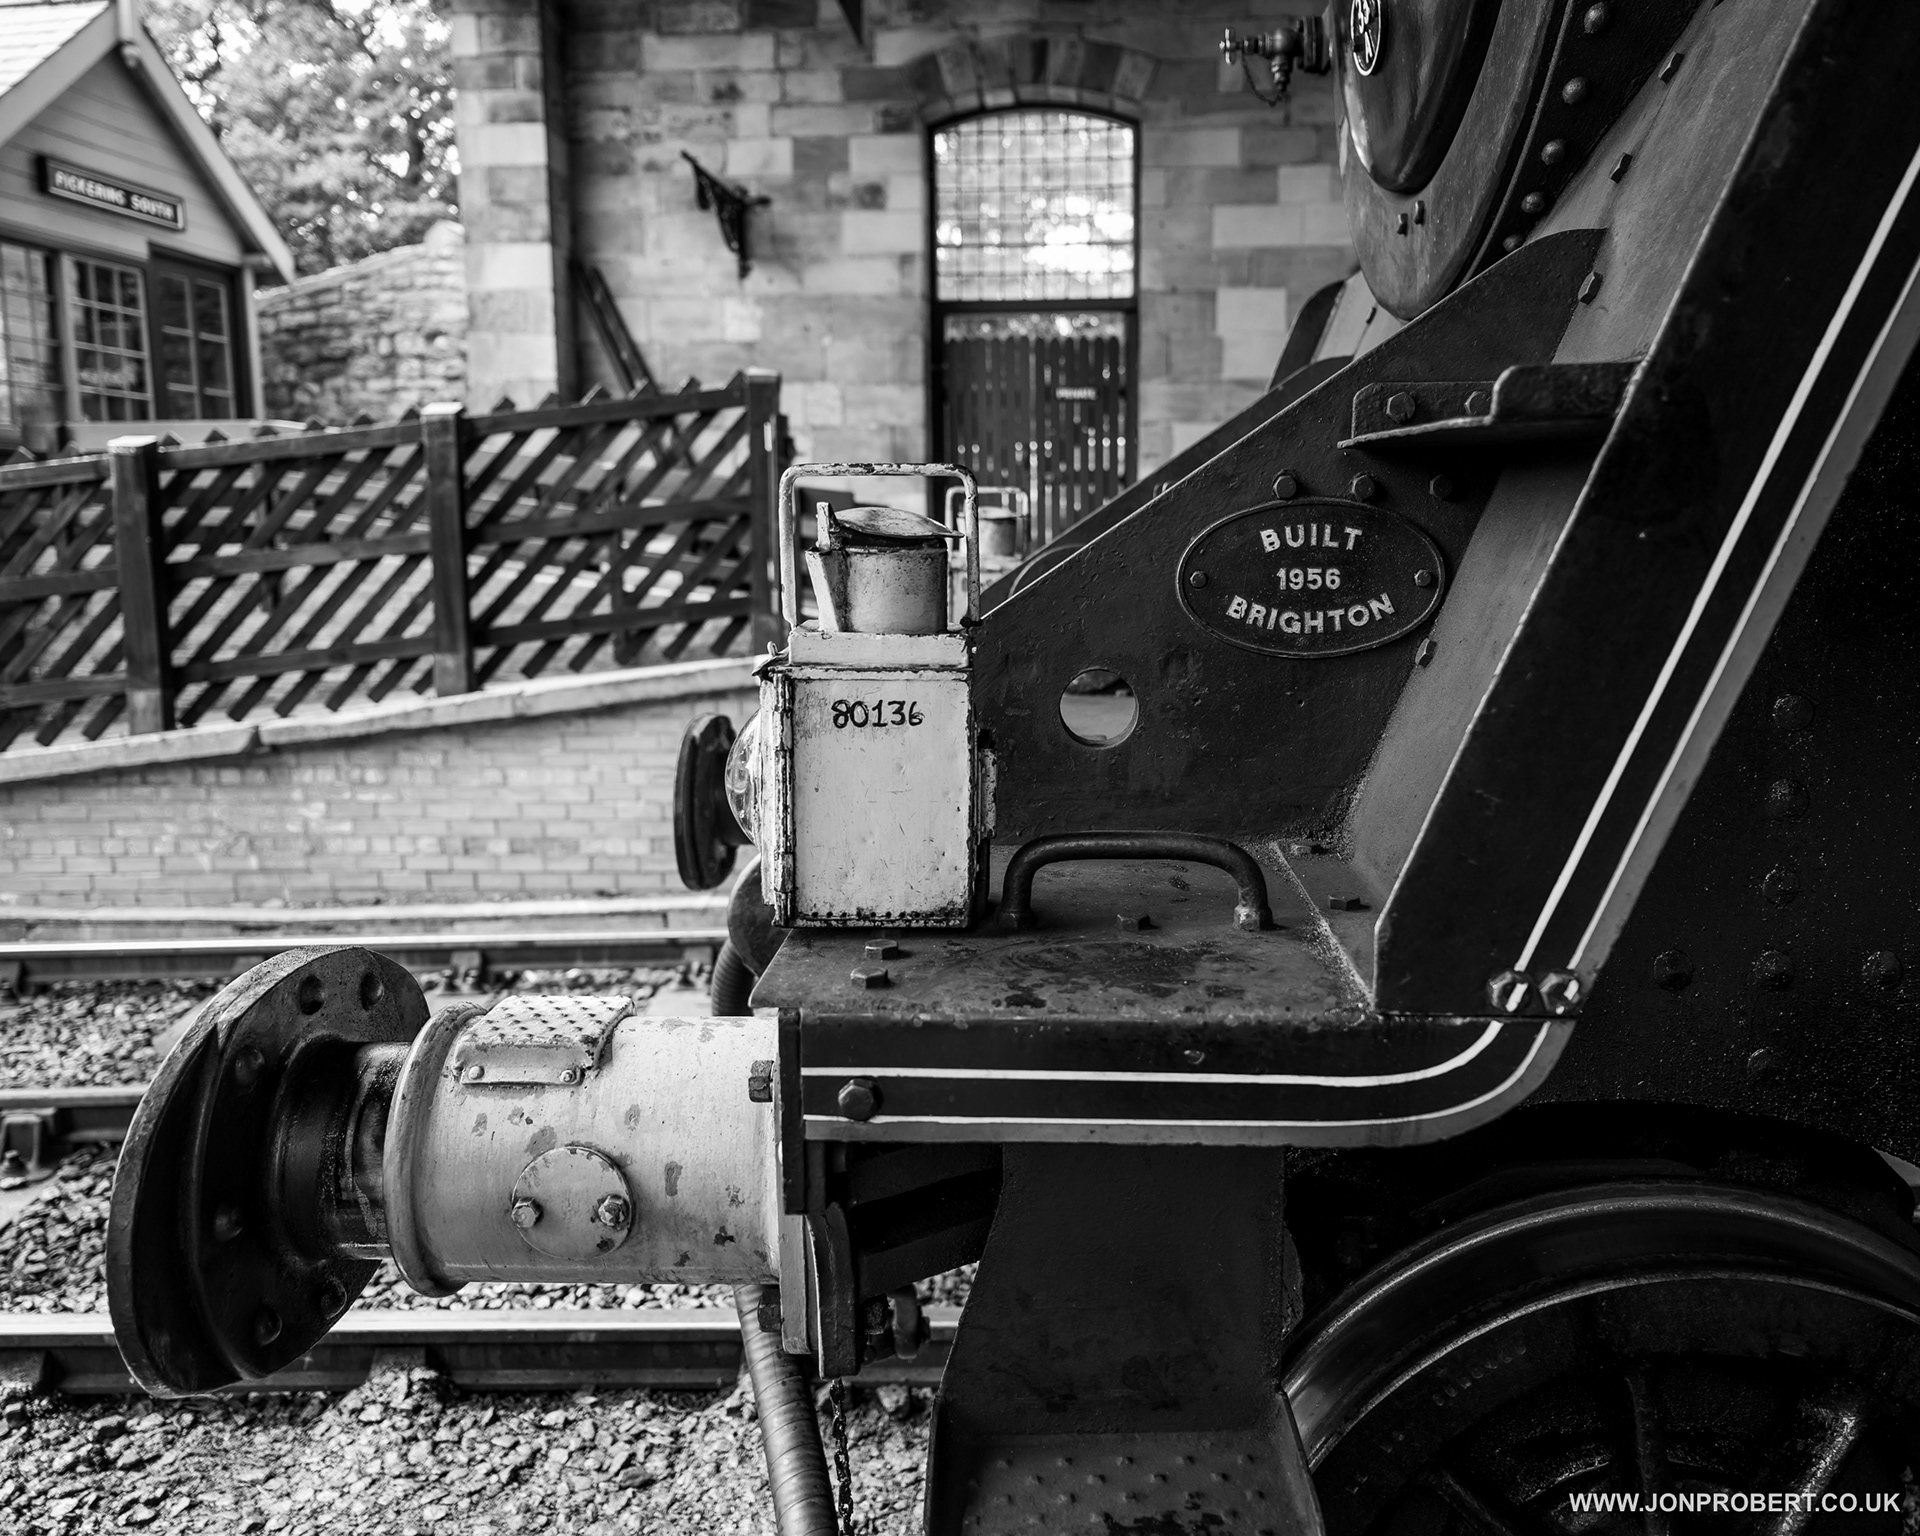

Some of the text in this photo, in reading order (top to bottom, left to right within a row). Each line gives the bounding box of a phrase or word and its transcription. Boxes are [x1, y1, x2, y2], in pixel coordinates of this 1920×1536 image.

[1260, 523, 1363, 553] BUILT
[1276, 567, 1341, 590] 1956
[1226, 593, 1395, 634] BRIGHTON
[831, 699, 925, 728] 80136
